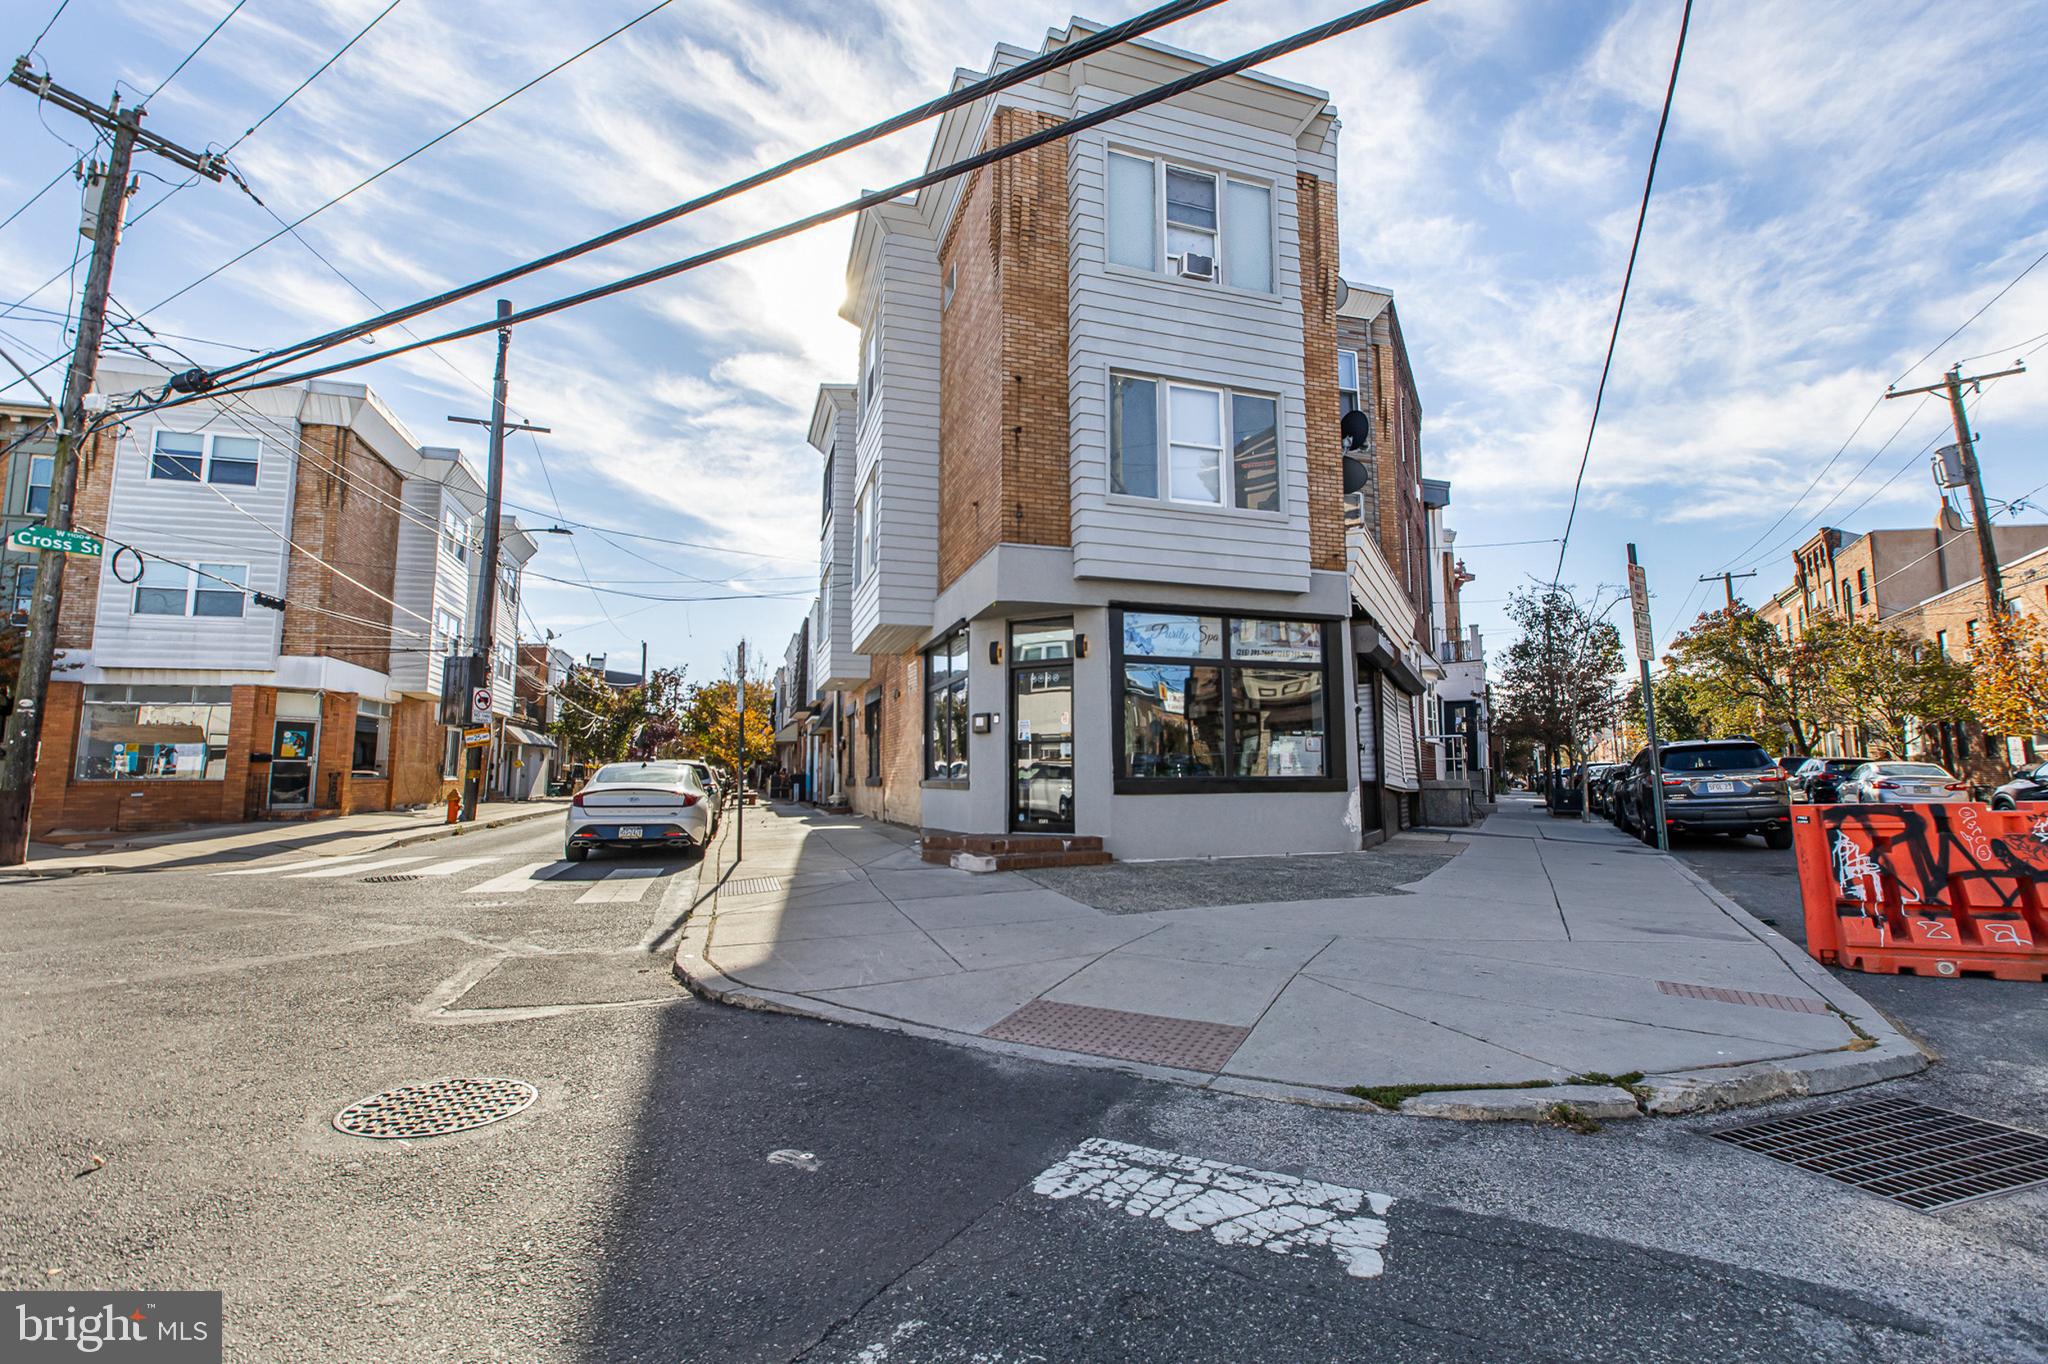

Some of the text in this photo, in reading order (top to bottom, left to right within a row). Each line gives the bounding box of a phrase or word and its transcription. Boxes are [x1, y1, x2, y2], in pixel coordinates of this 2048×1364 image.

[17, 531, 100, 555] Cross St
[1151, 623, 1219, 650] Purity Spa
